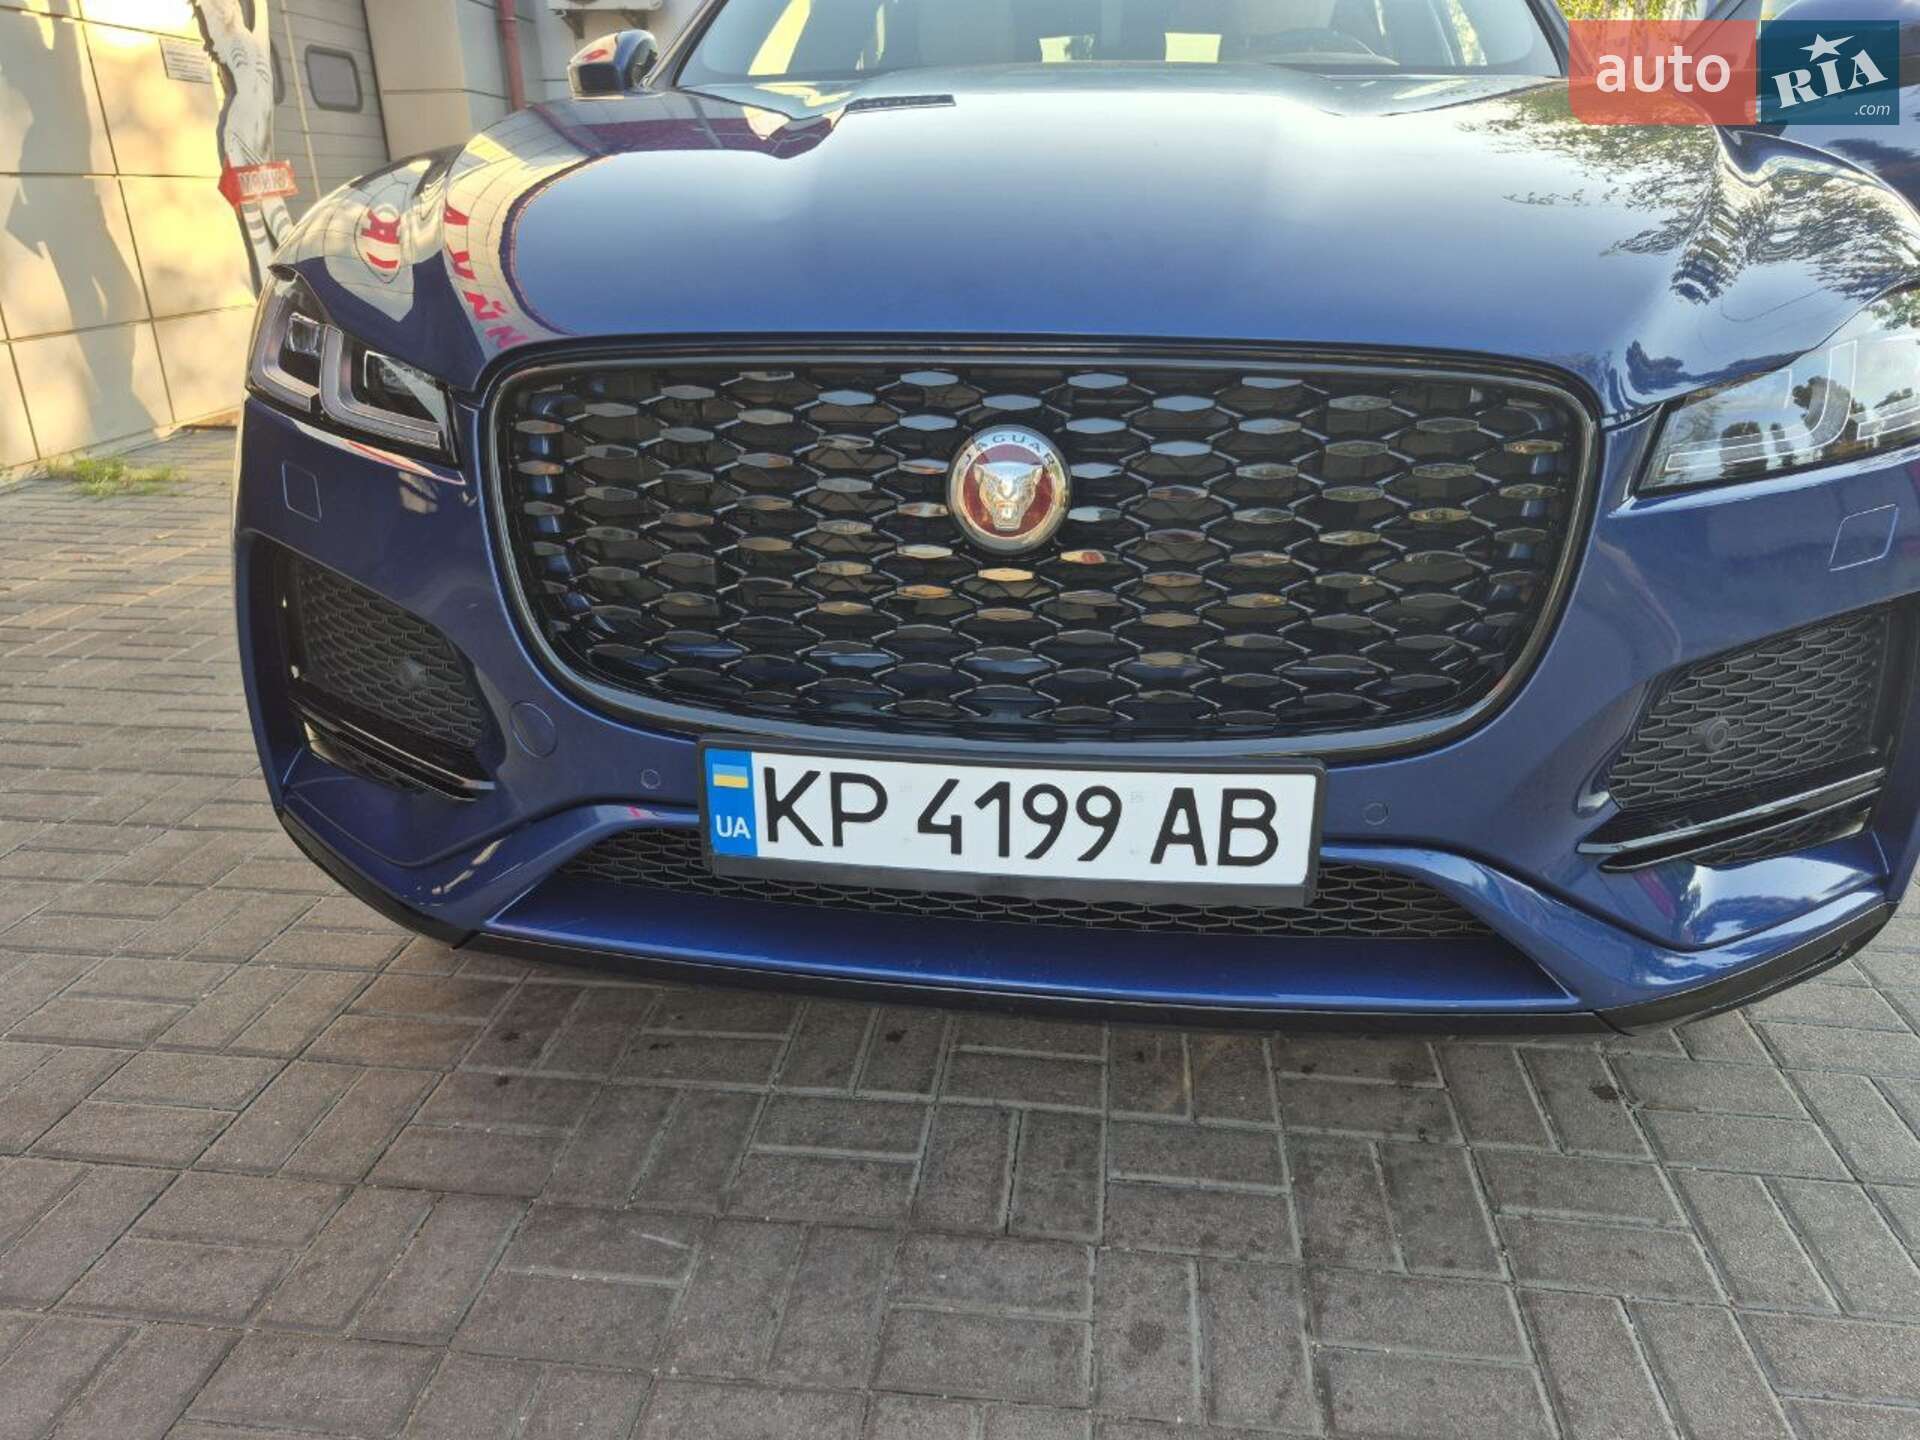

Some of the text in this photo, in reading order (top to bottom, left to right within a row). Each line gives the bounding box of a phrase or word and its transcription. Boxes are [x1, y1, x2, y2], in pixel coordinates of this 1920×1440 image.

[716, 816, 751, 840] UA
[763, 766, 1280, 867] KP 4199 AB
